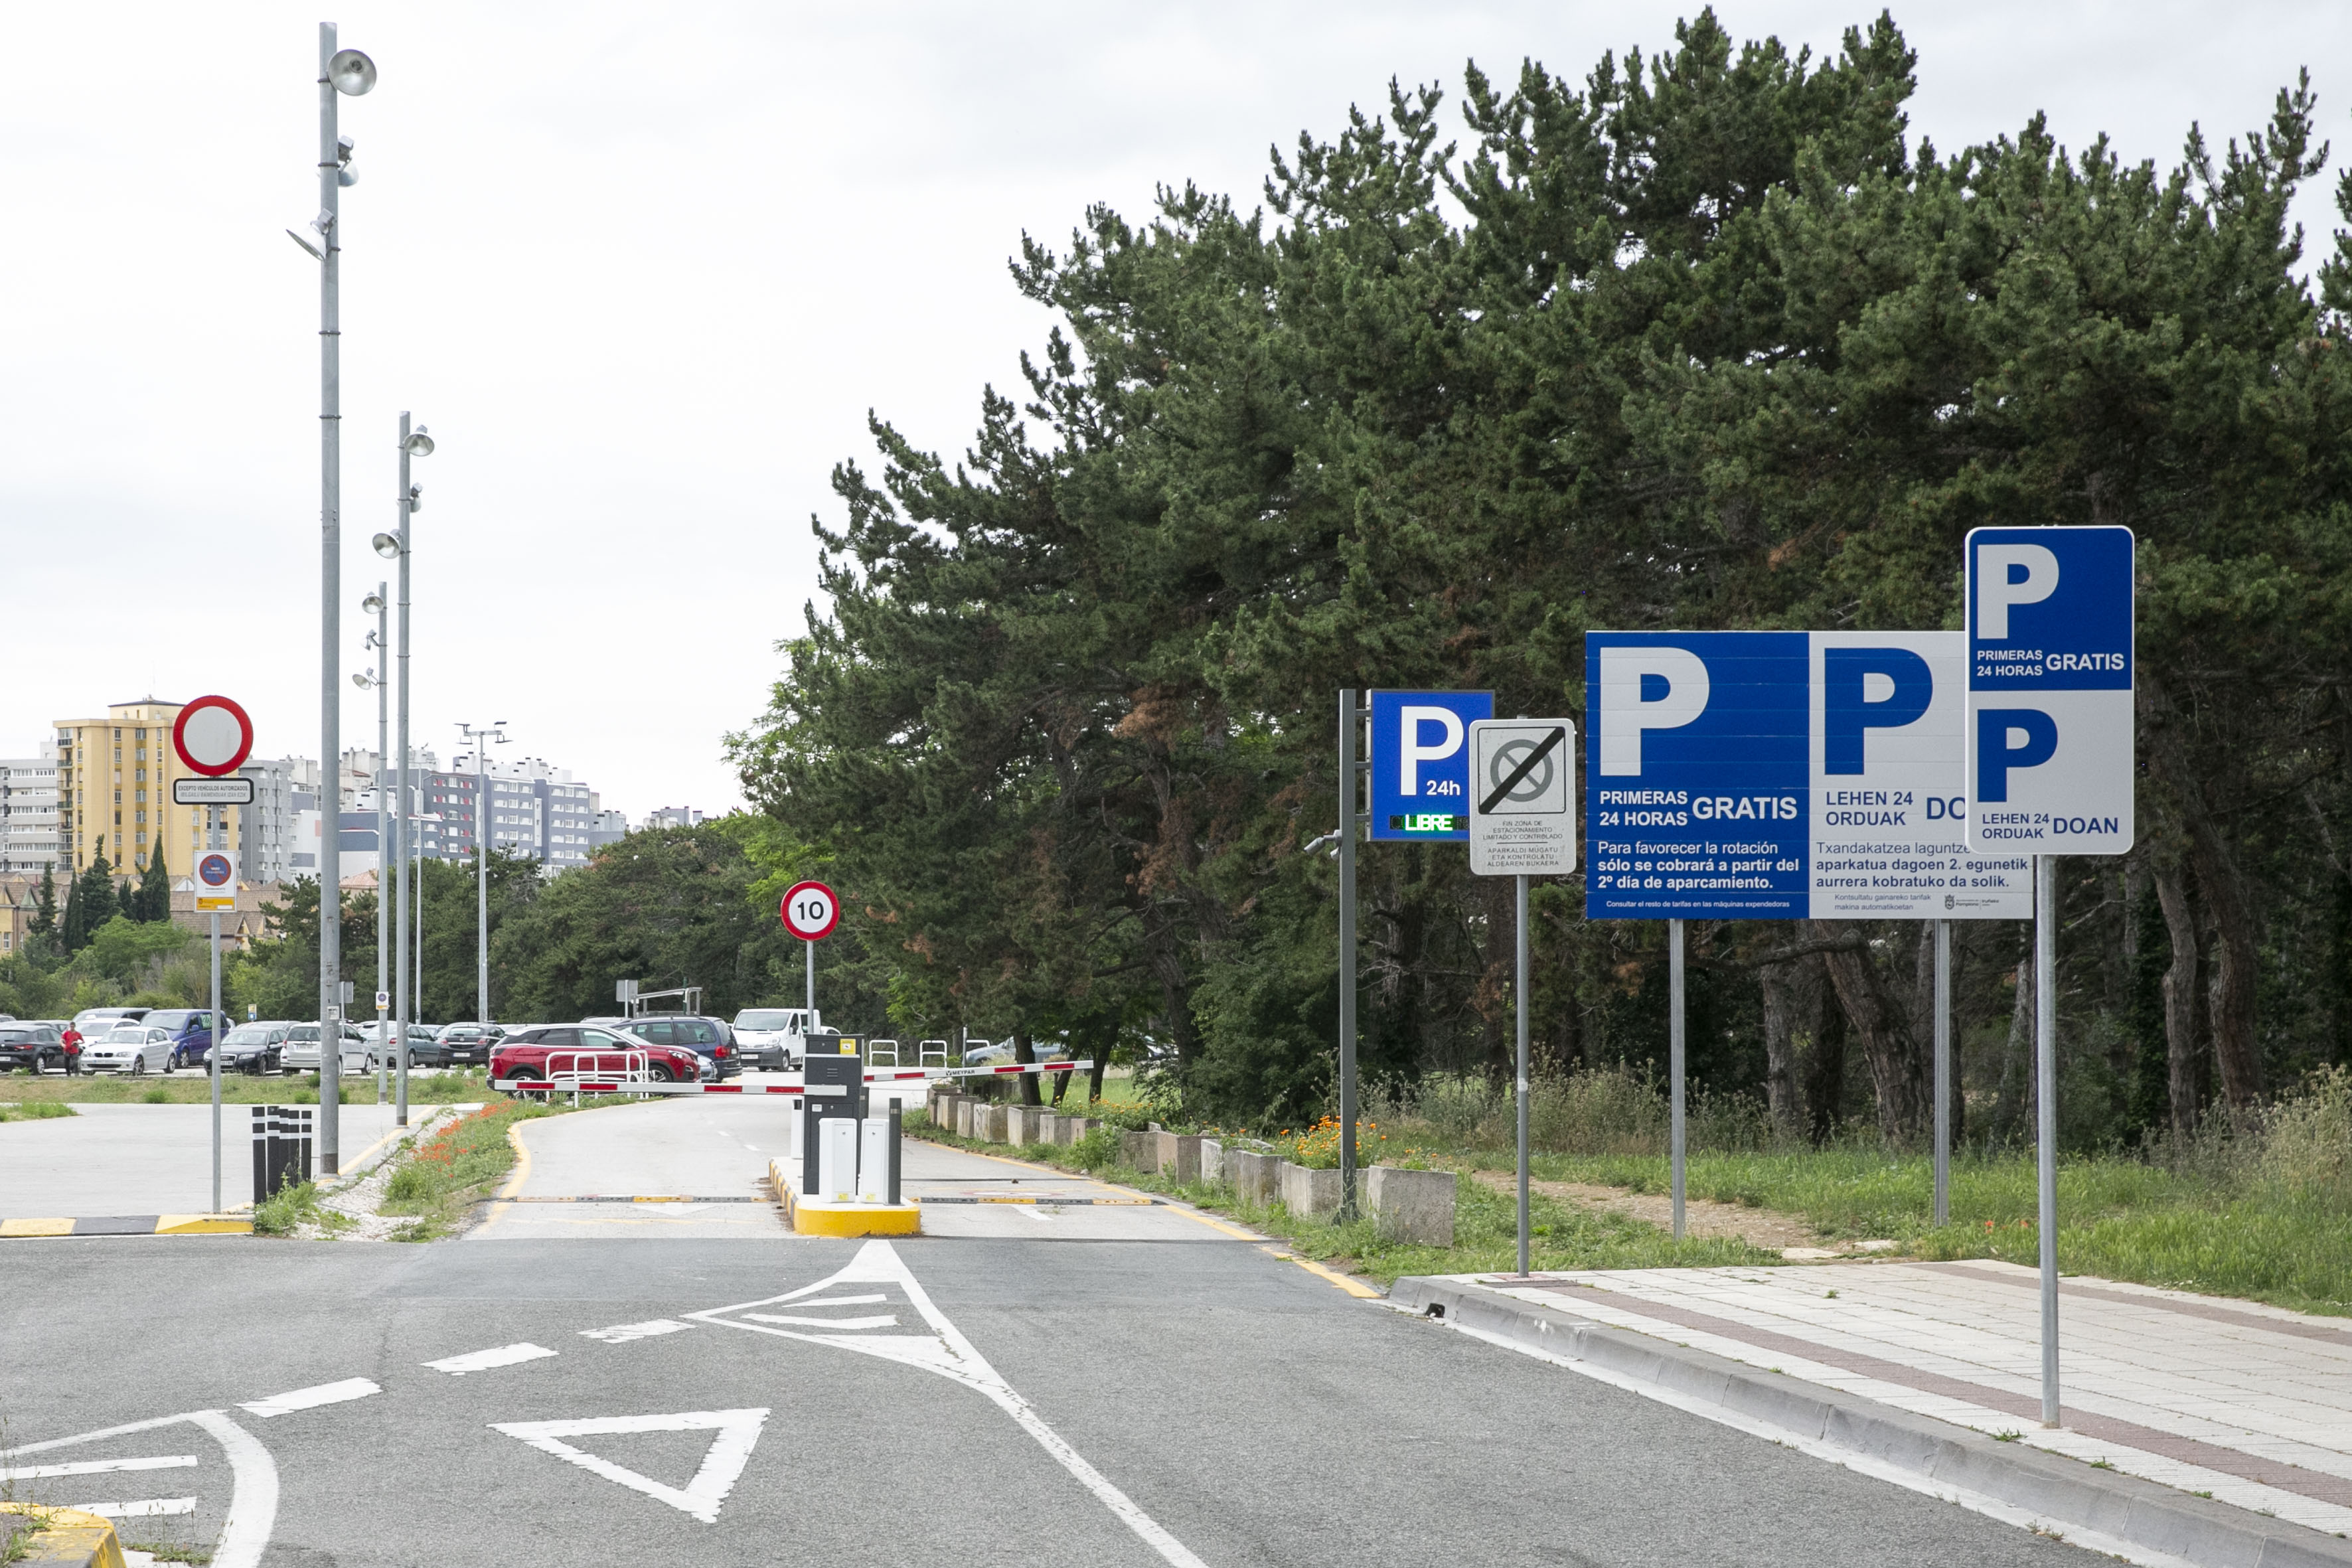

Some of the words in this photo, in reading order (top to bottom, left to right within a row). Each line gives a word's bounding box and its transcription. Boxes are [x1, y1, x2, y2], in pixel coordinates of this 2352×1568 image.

[1977, 544, 2059, 639] P
[1977, 649, 2043, 661] PRIMERAS
[2045, 653, 2125, 671] GRATIS
[1977, 665, 1992, 676] 24
[1996, 665, 2043, 676] HORAS
[1600, 647, 1710, 776] P
[1824, 647, 1933, 775] P
[1400, 706, 1464, 796] P
[1977, 708, 2058, 803] P
[1426, 779, 1461, 797] 24h
[1600, 791, 1688, 805] PRIMERAS
[1826, 791, 1887, 805] LEHEN
[1893, 791, 1913, 805] 24
[1692, 797, 1798, 820] GRATIS
[1405, 814, 1453, 831] LIBRE
[1599, 811, 1620, 826] 24
[1624, 811, 1688, 826] HORAS
[1826, 811, 1906, 826] ORDUAK
[1982, 813, 2029, 824] LEHEN
[2033, 813, 2050, 824] 24
[2053, 817, 2118, 834] DOAN
[1982, 828, 2044, 839] ORDUAK
[1598, 840, 1631, 854] Para
[1635, 840, 1702, 854] favorecer
[1705, 841, 1718, 854] la
[1722, 840, 1778, 854] rotación
[1816, 842, 1911, 854] Txandakatzea
[1598, 858, 1630, 872] sólo
[1634, 861, 1652, 872] se
[1656, 858, 1714, 872] cobrará
[1718, 861, 1728, 872] a
[1732, 858, 1773, 874] partir
[1776, 858, 1799, 872] del
[1816, 858, 1887, 873] aparkatua
[1891, 858, 1944, 873] dagoen
[1949, 858, 1962, 870] 2.
[1966, 858, 2028, 873] egunetik
[1598, 875, 1613, 888] 2º
[1616, 875, 1640, 889] día
[1644, 875, 1662, 889] de
[1666, 875, 1773, 892] aparcamiento.
[1816, 878, 1867, 888] aurrera
[1873, 875, 1945, 888] kobratuko
[1949, 875, 1966, 888] da
[1971, 875, 2009, 888] solik.
[1713, 900, 1745, 909] máquinas
[1745, 900, 1790, 909] expendedoras
[1874, 894, 1909, 903] gainareko
[797, 901, 824, 920] 10
